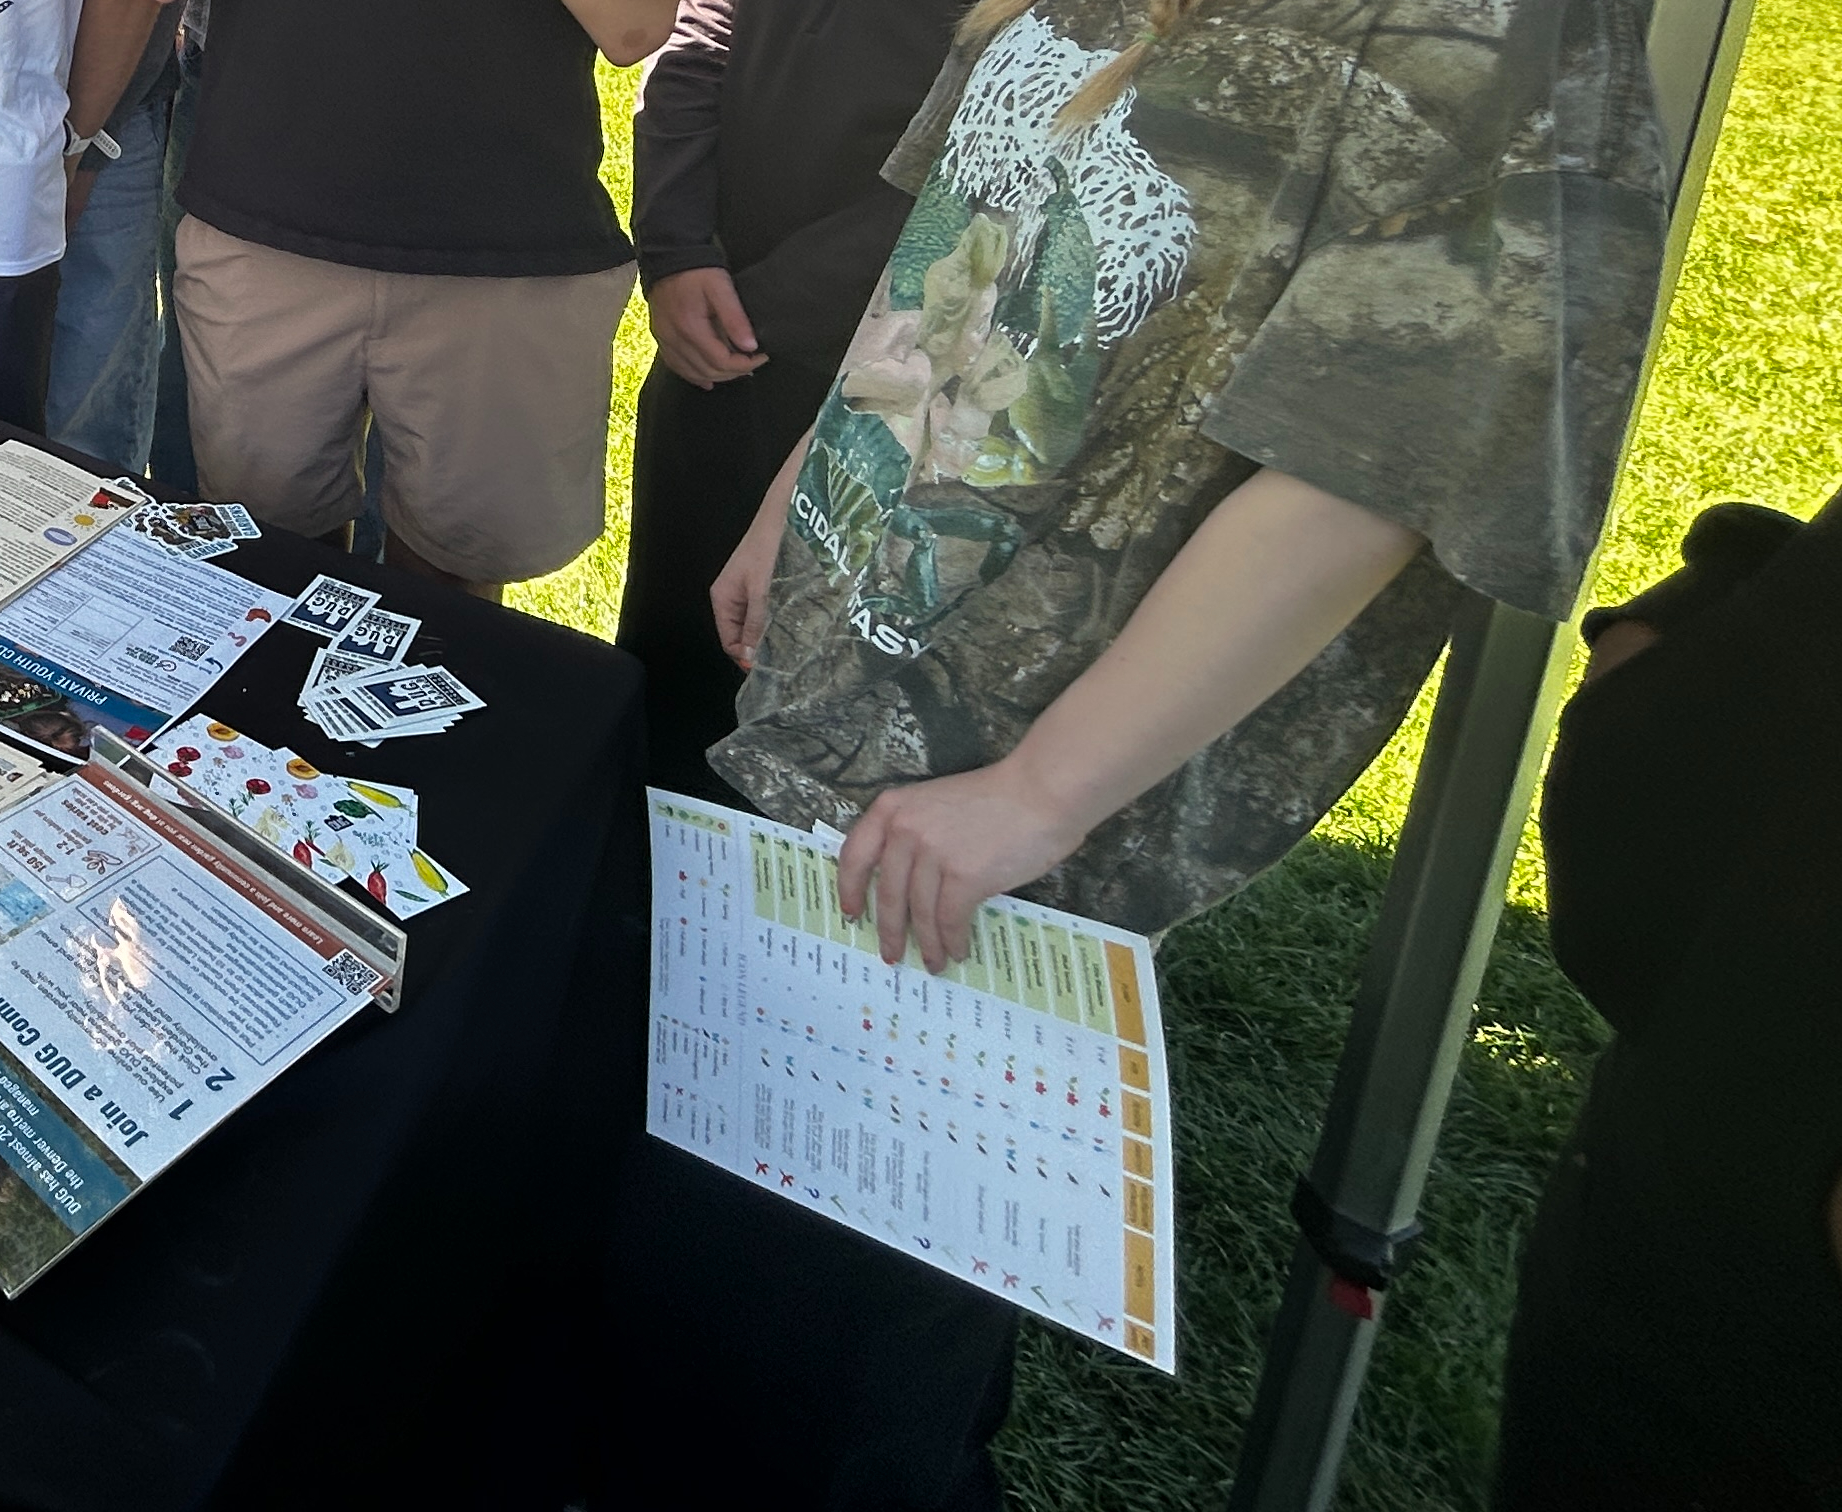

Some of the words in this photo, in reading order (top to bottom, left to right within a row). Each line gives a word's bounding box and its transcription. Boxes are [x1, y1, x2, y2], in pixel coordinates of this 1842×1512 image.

[312, 596, 350, 617] DUG
[13, 655, 54, 680] YOUTH
[54, 675, 107, 704] PRIVATE
[61, 799, 88, 820] varies
[86, 819, 108, 835] cost
[6, 839, 29, 856] sq.ft
[56, 840, 74, 855] 1-2
[26, 856, 46, 872] 150
[35, 929, 58, 947] email
[56, 947, 74, 961] and
[10, 960, 20, 969] to
[19, 968, 37, 984] map
[37, 971, 54, 987] with
[37, 984, 67, 1009] garden
[54, 985, 71, 1000] you
[123, 991, 132, 1000] to
[67, 1000, 87, 1017] near
[132, 1000, 161, 1026] Leader
[227, 1009, 245, 1023] year
[133, 1013, 165, 1039] garden
[245, 1023, 264, 1039] each
[124, 1038, 144, 1054] plot
[161, 1024, 193, 1054] Garden
[163, 1040, 178, 1054] the
[34, 1043, 85, 1089] DUG
[107, 1049, 132, 1071] online
[119, 1047, 141, 1067] DUG
[178, 1053, 200, 1074] Click
[193, 1053, 208, 1068] the
[132, 1072, 147, 1085] our
[141, 1054, 184, 1088] potential
[141, 1065, 173, 1095] explore
[205, 1067, 235, 1091] 2
[83, 1084, 102, 1100] a
[147, 1085, 165, 1103] Use
[168, 1098, 193, 1120] 1
[6, 1109, 35, 1137] metro
[100, 1101, 148, 1146] Join
[8, 1137, 41, 1171] almost
[32, 1137, 67, 1172] Denver
[39, 1169, 59, 1191] has
[65, 1169, 83, 1189] the
[54, 1187, 81, 1213] DUG
